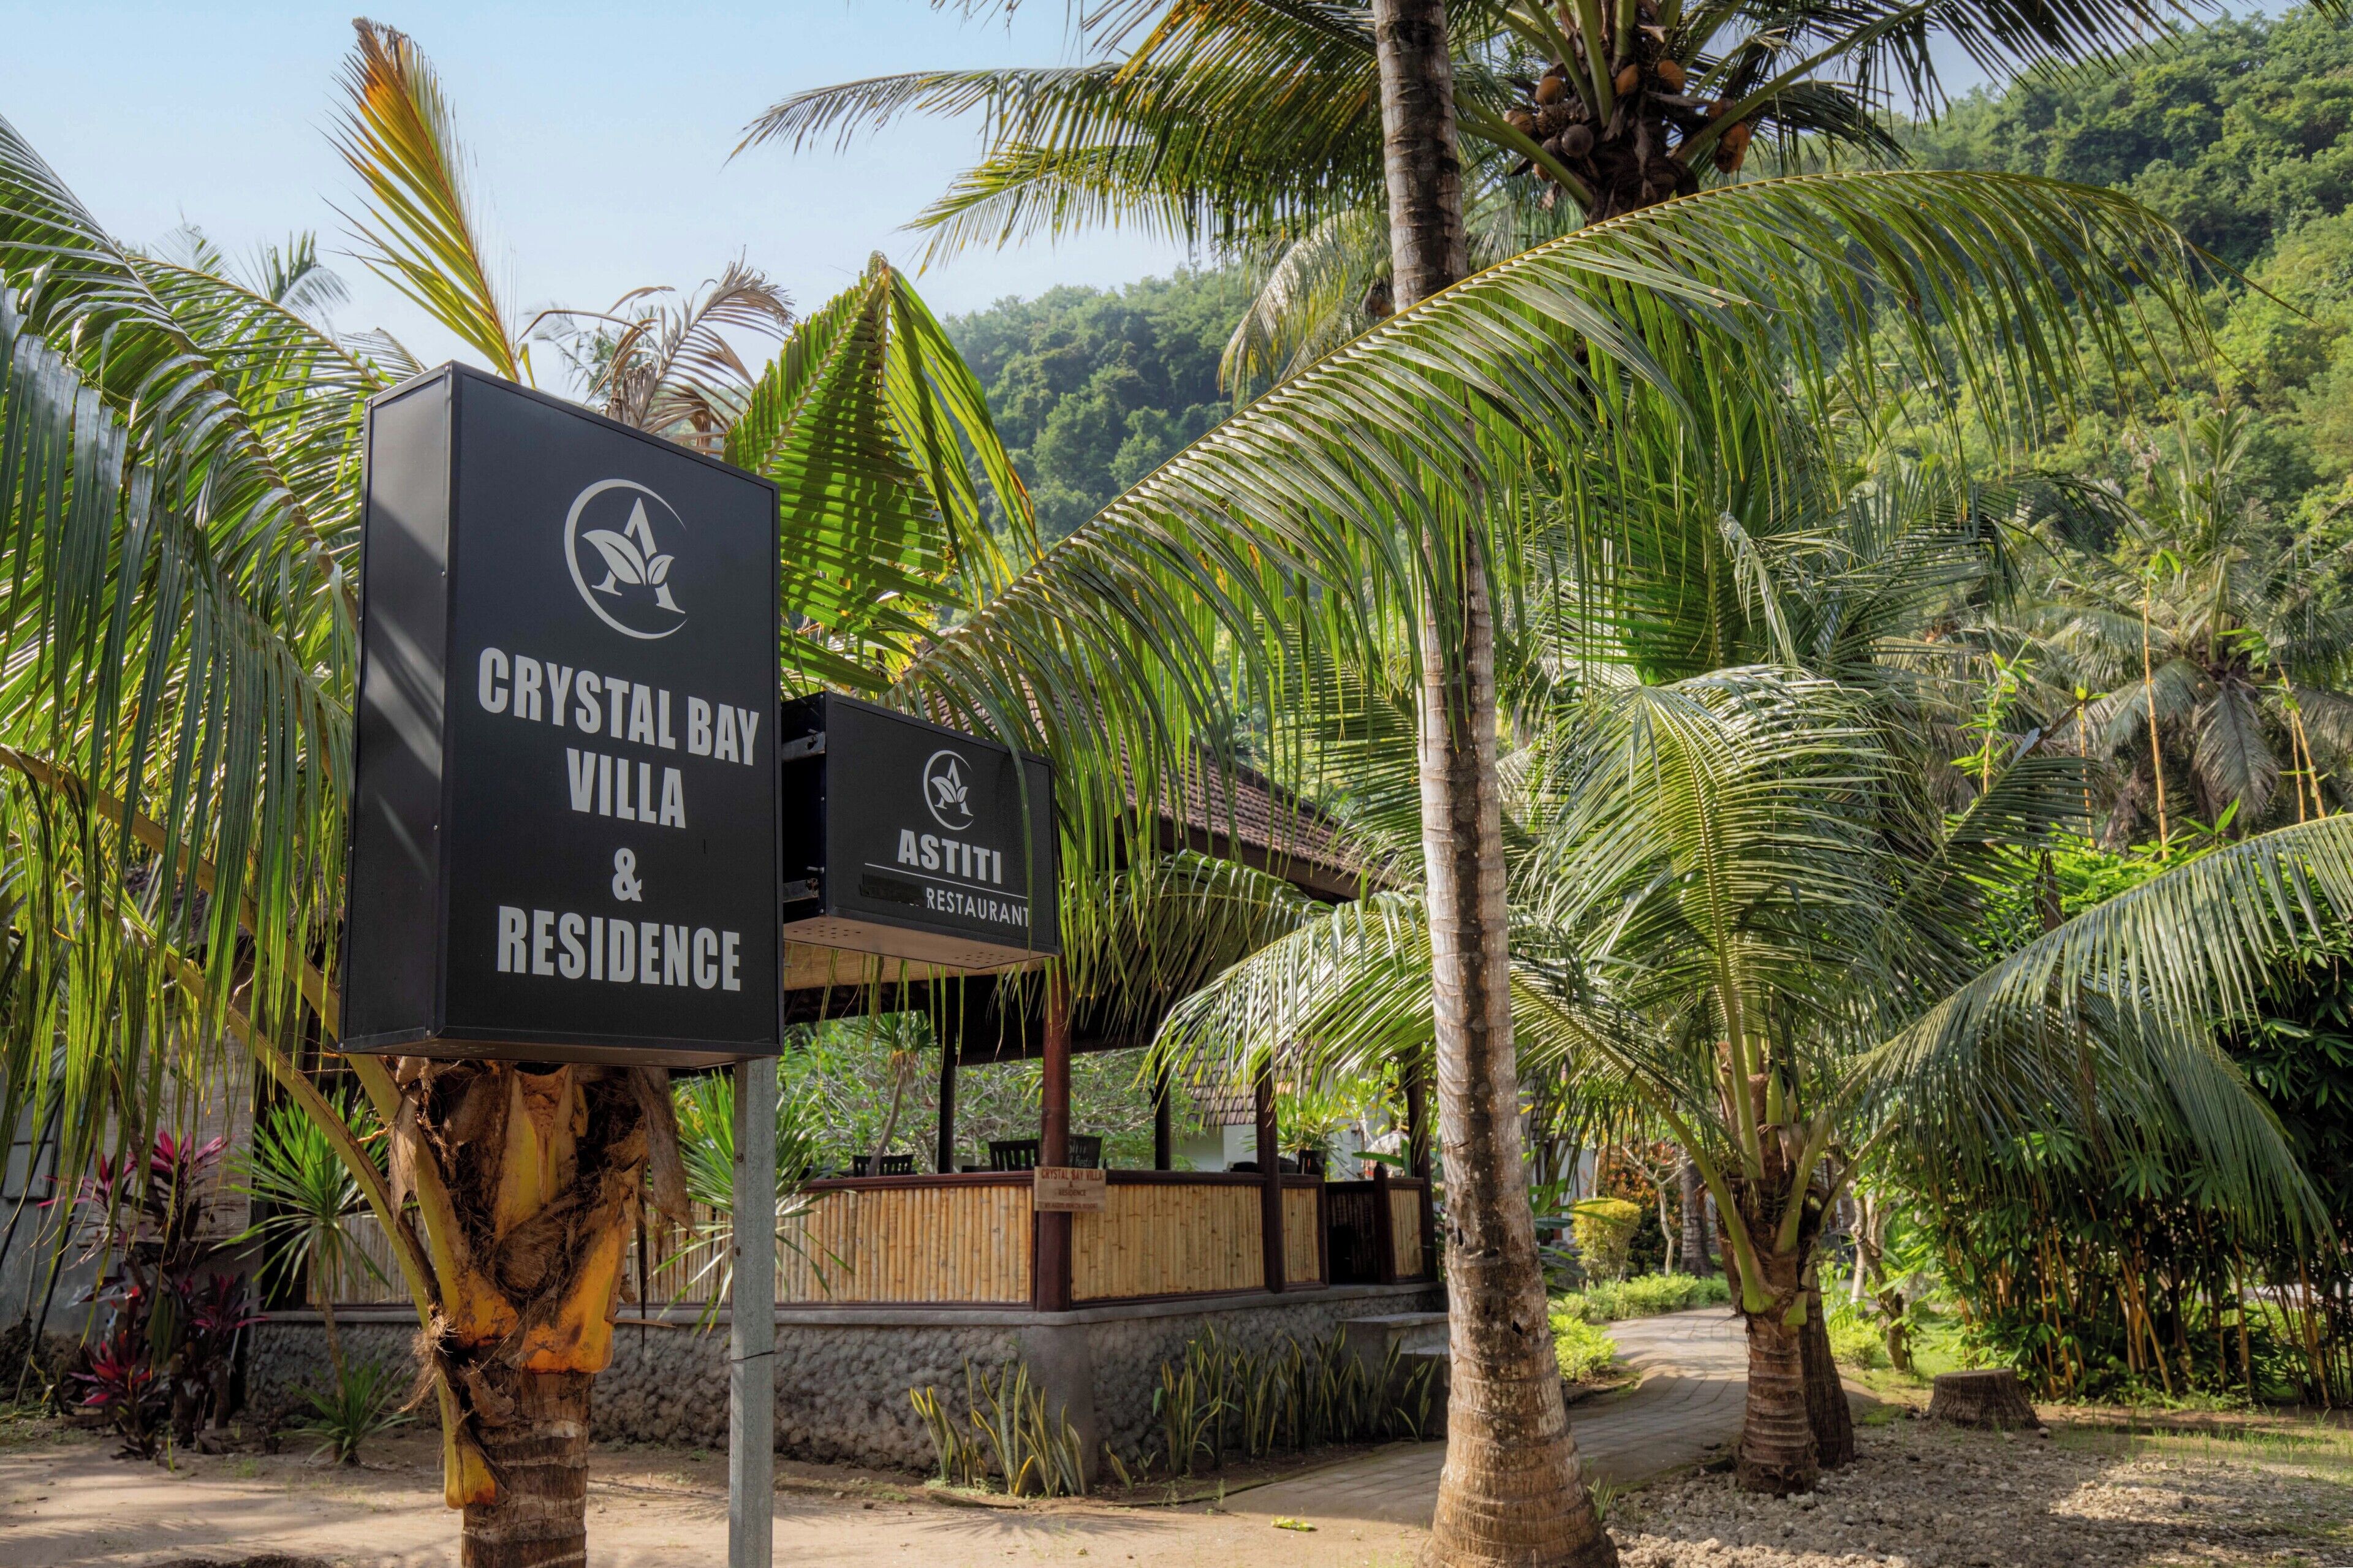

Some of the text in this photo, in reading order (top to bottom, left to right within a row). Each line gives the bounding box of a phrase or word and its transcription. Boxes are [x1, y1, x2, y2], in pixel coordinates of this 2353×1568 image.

[479, 647, 760, 766] CRYSTAL BAY
[566, 748, 686, 828] VILLA
[612, 847, 642, 902] &
[898, 828, 1002, 884] ASTITI
[926, 887, 1029, 927] RESTAURANT
[497, 906, 740, 991] RESIDENCE
[1041, 1168, 1102, 1181] CRYSTAL BAY VILLA
